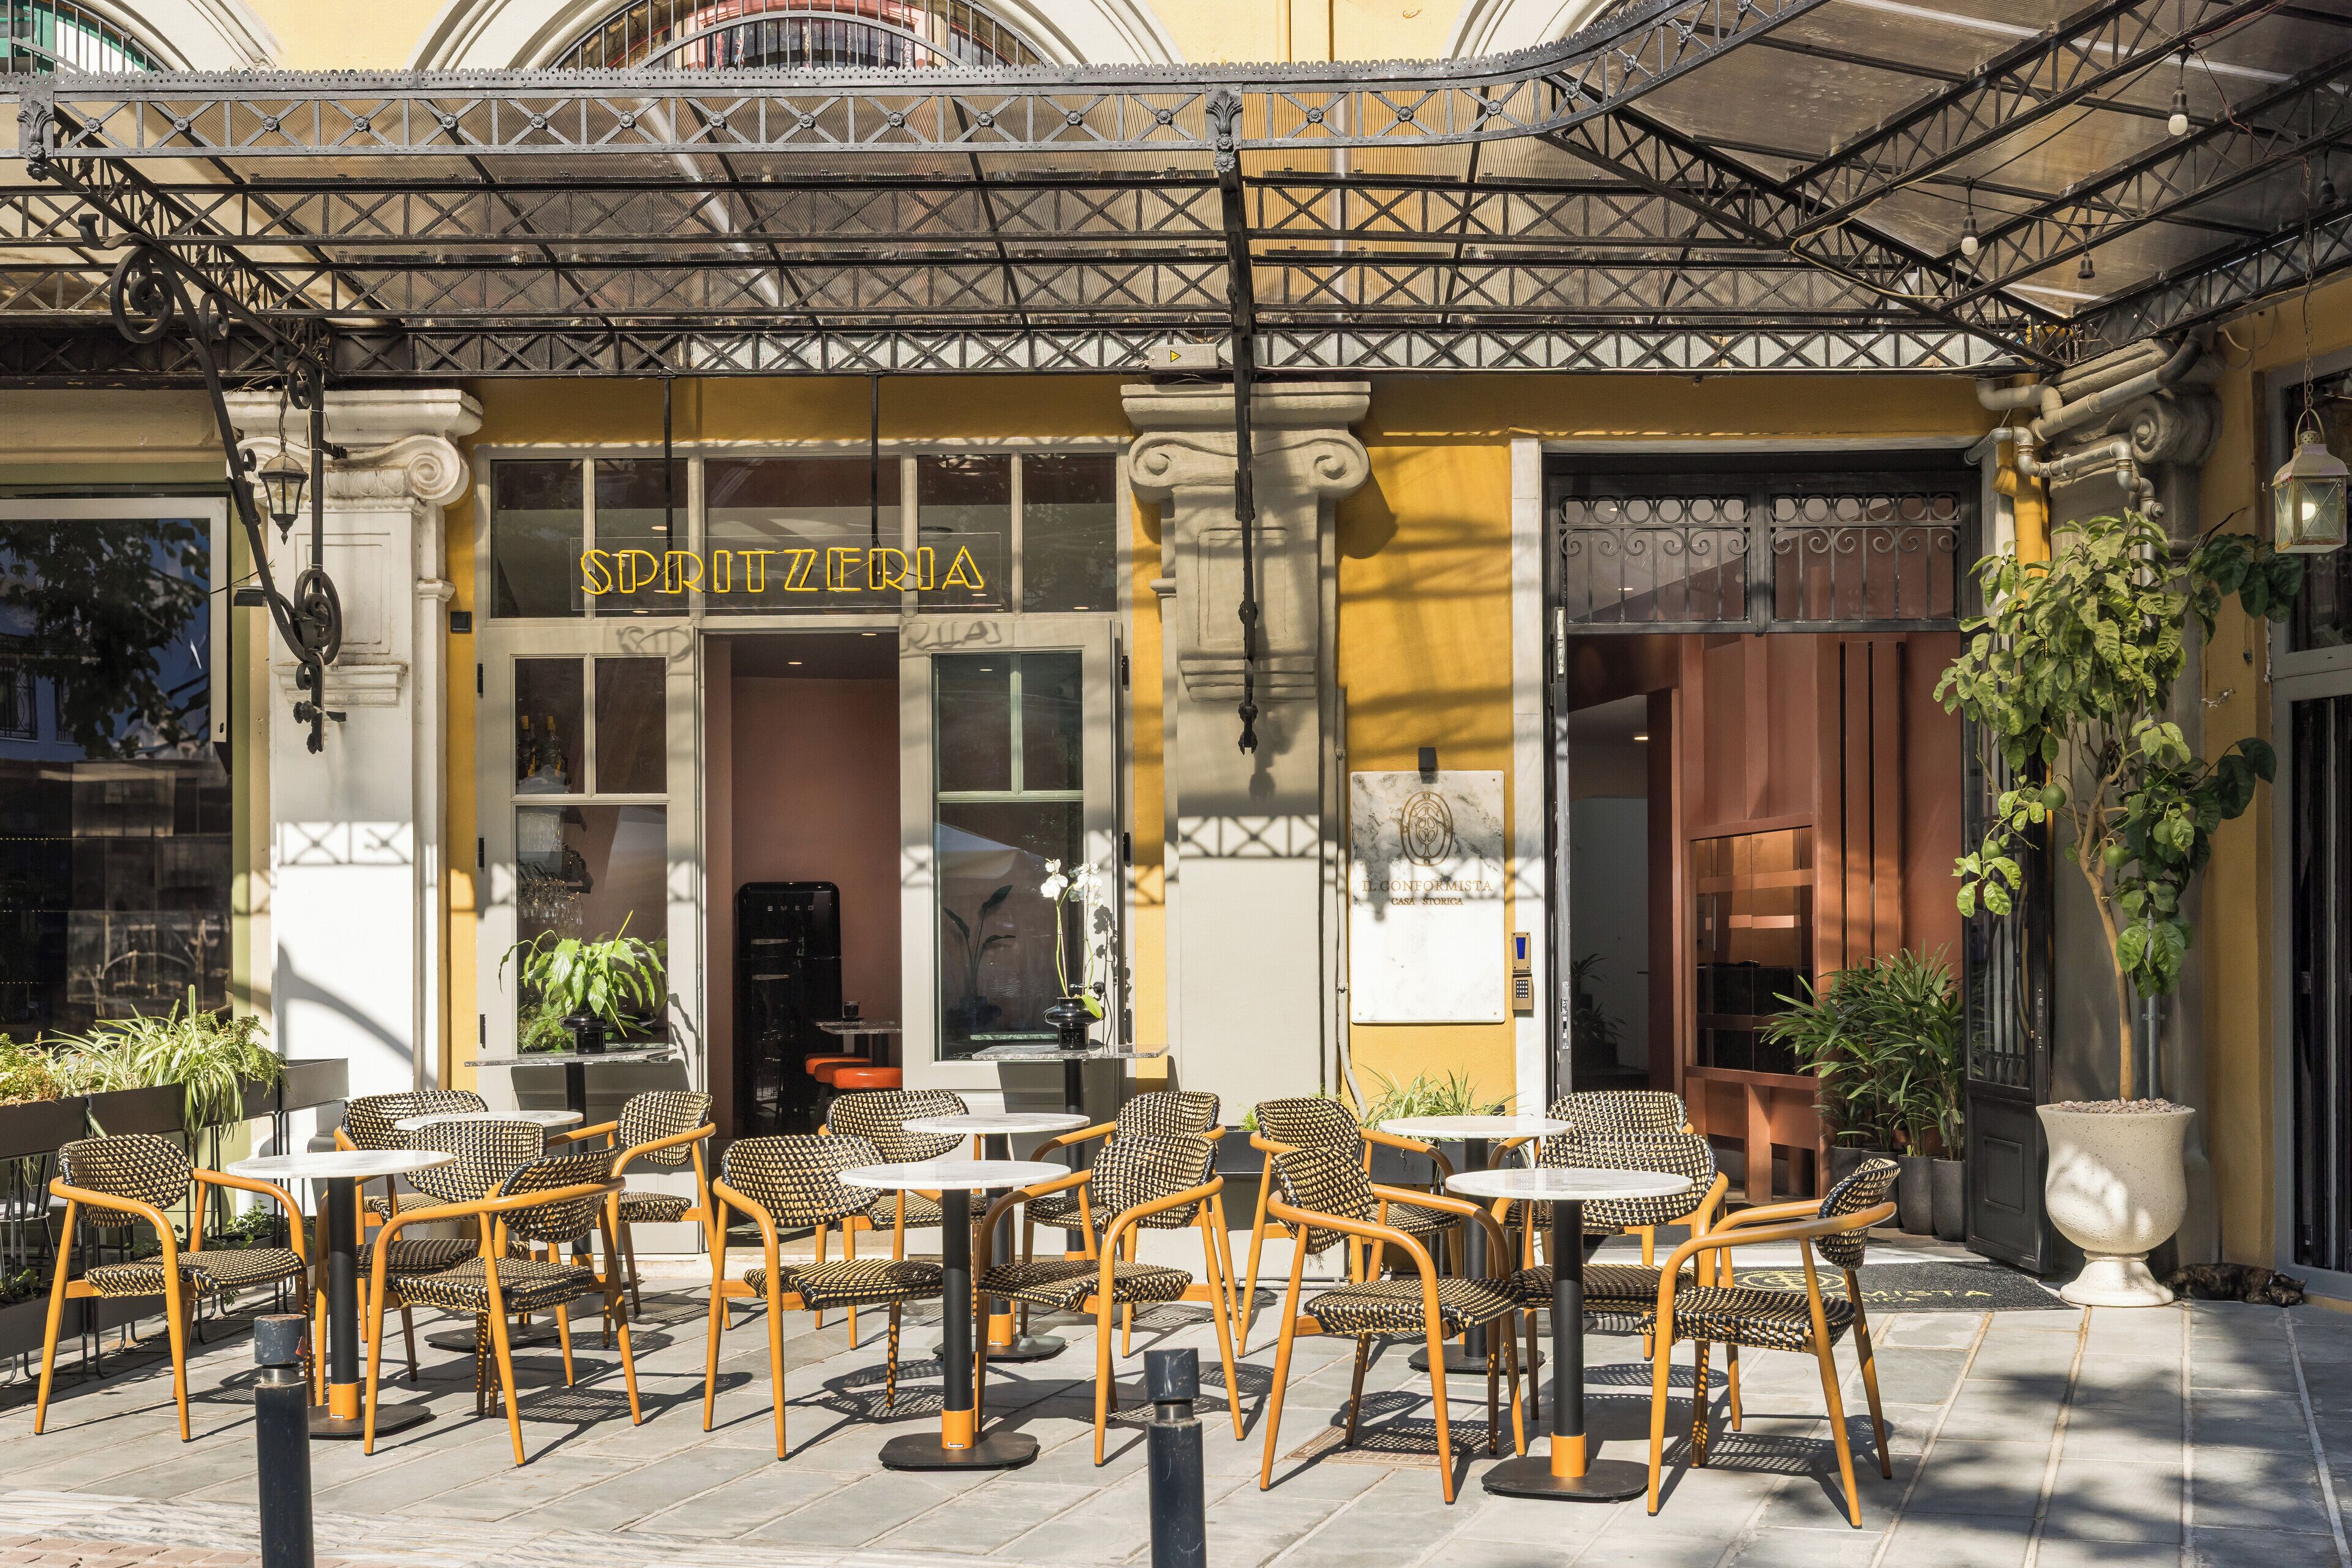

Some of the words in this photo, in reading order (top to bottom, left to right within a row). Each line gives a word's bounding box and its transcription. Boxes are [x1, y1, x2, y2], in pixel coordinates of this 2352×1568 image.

[580, 545, 986, 595] SPRITZERIA
[1362, 880, 1376, 892] IL
[1379, 880, 1493, 892] CONFORMISTA
